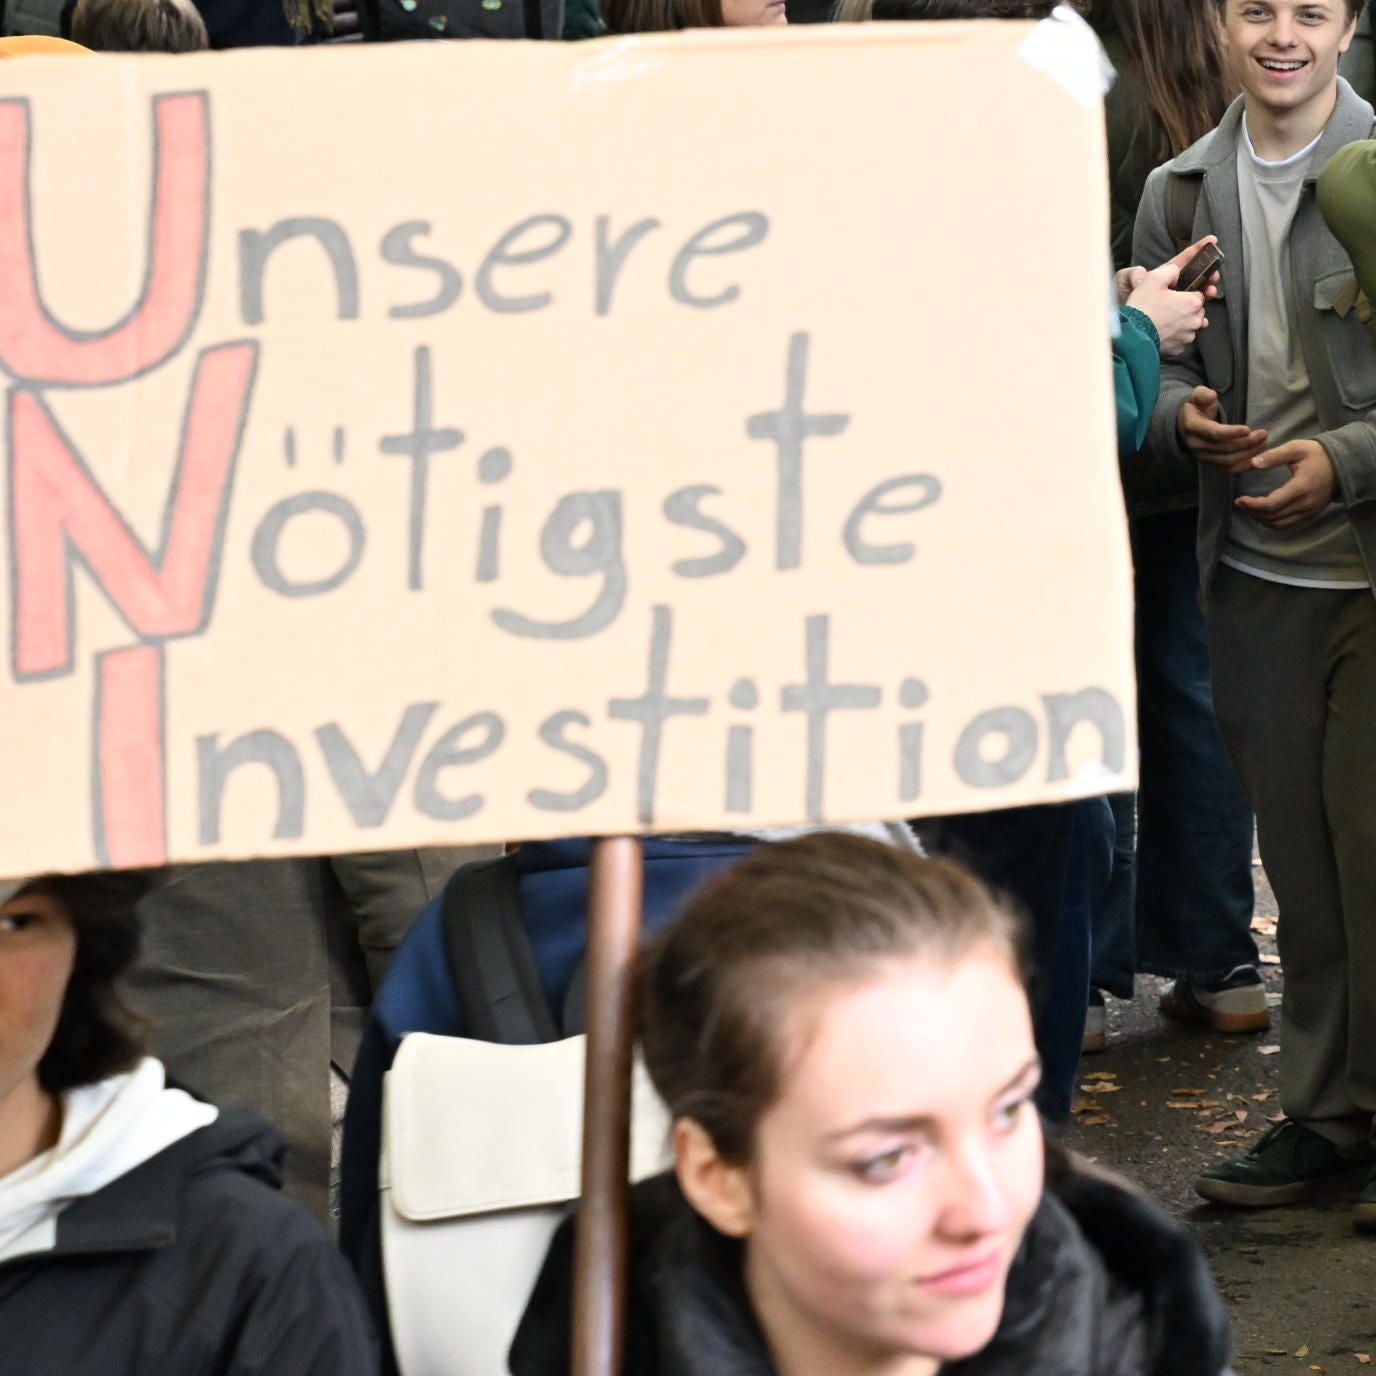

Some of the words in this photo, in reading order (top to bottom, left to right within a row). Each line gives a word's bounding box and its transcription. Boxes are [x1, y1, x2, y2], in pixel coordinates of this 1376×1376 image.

[0, 89, 771, 389] Unsere
[4, 331, 944, 683] Nötigste
[90, 602, 1128, 871] Investition
